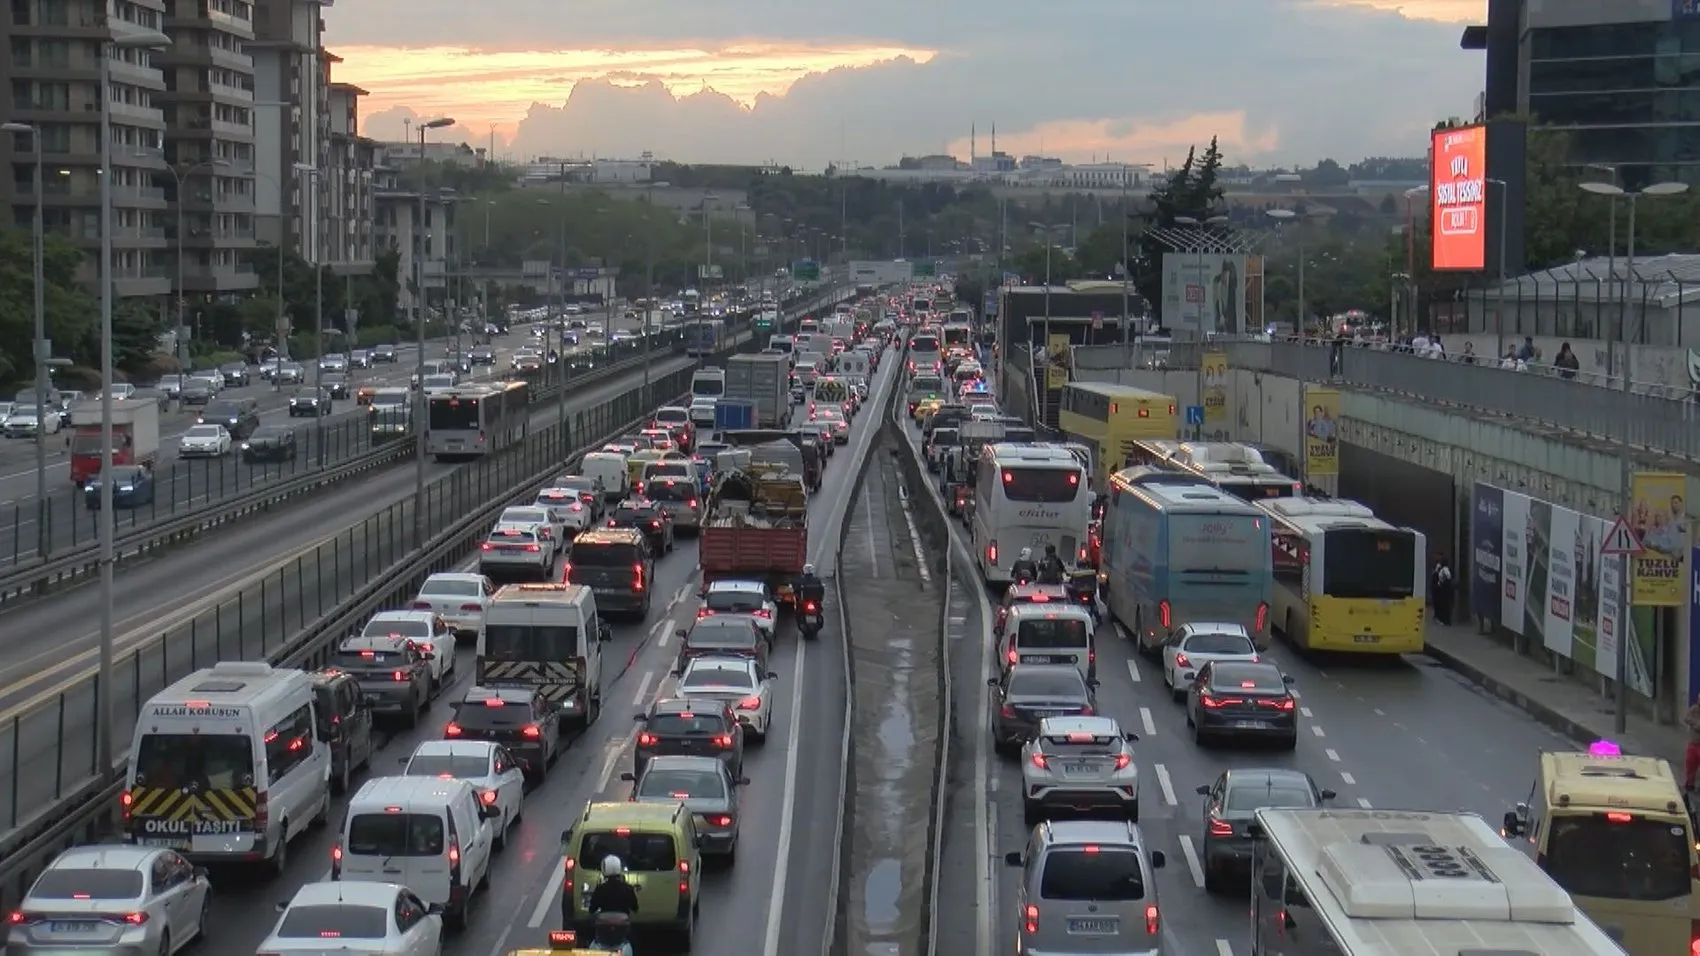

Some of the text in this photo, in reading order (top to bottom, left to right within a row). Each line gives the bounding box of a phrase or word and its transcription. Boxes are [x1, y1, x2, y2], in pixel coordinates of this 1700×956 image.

[1638, 559, 1679, 568] TUZLU
[1637, 569, 1678, 578] KAHVE
[152, 707, 240, 717] ALLAH KORUSUN
[145, 820, 188, 832] OKUL
